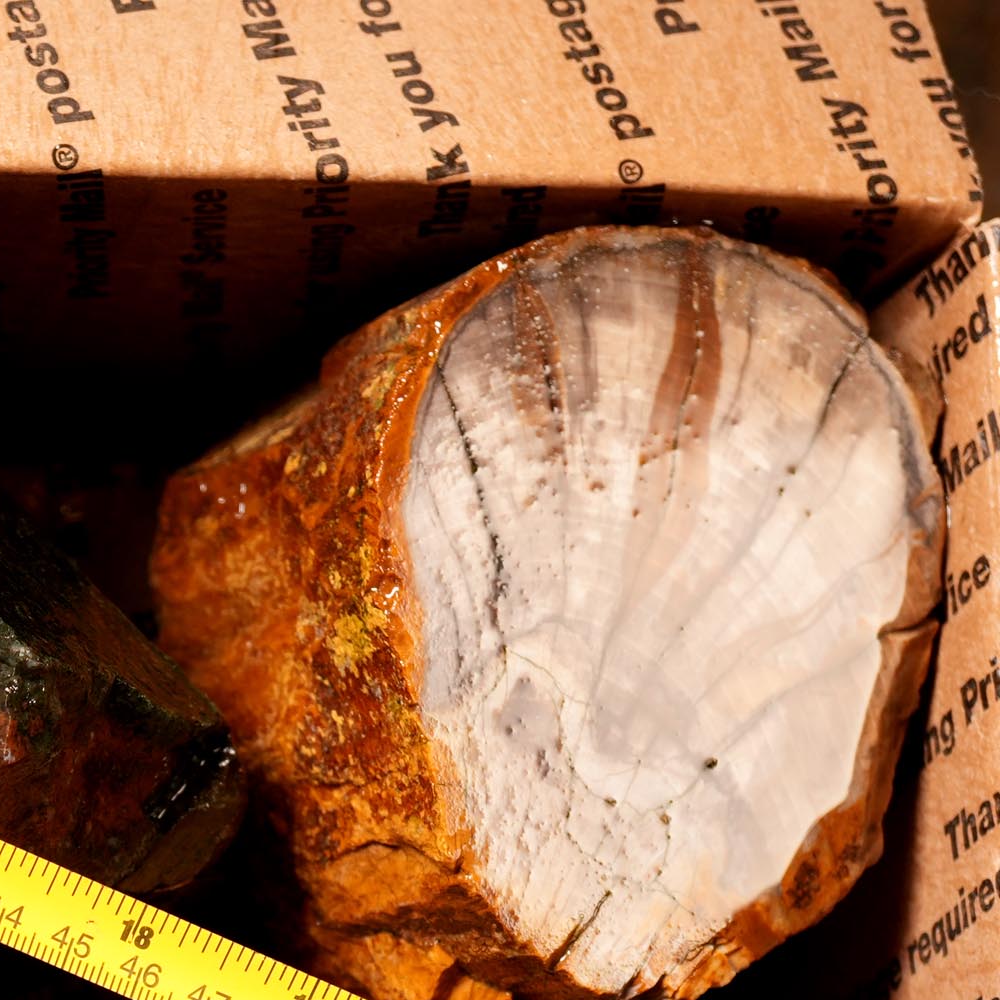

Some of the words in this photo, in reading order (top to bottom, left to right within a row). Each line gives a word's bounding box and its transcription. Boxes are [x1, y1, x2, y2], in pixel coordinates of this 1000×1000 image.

[755, 0, 838, 81] Mai
[874, 1, 931, 62] for
[386, 51, 459, 132] you
[277, 75, 350, 218] Priority
[418, 144, 471, 238] Thank
[914, 229, 992, 318] Than
[51, 926, 94, 959] 45
[119, 955, 163, 988] 46
[120, 919, 154, 950] 18
[907, 868, 1000, 975] require
